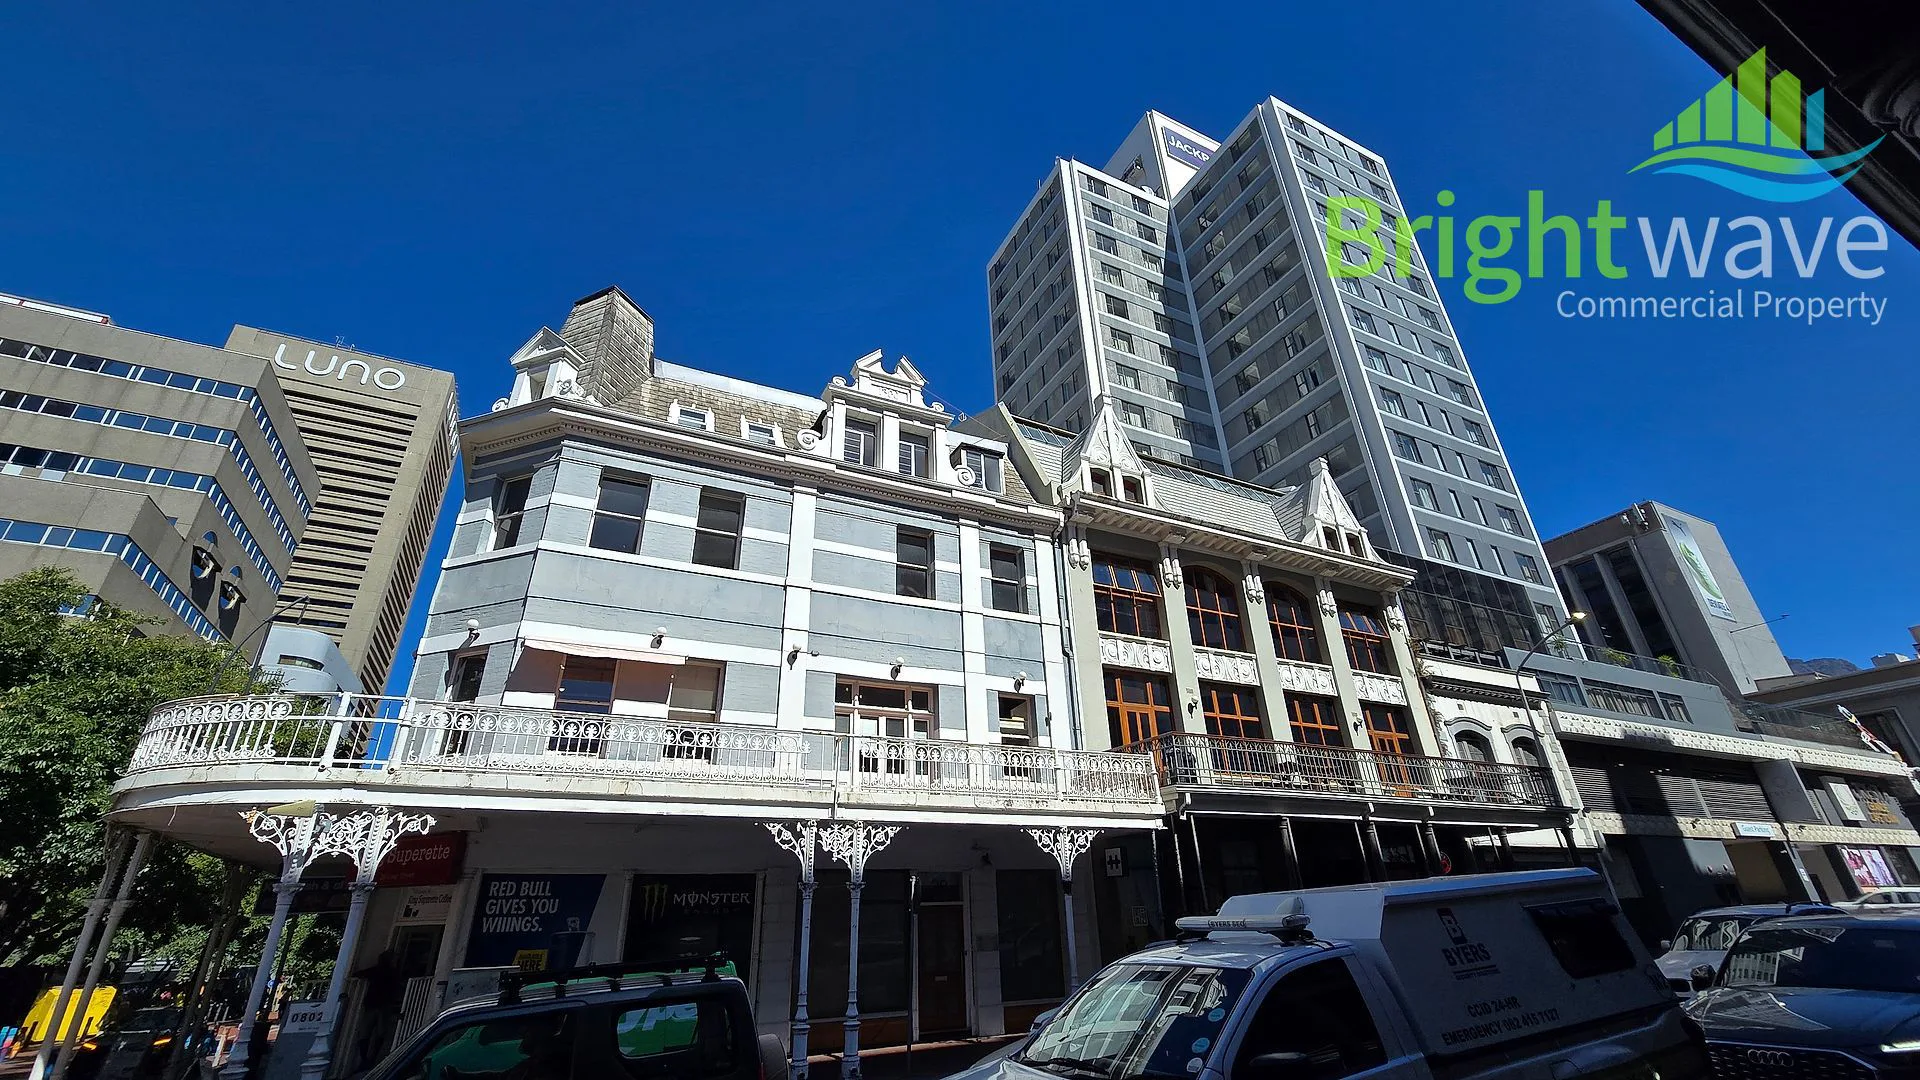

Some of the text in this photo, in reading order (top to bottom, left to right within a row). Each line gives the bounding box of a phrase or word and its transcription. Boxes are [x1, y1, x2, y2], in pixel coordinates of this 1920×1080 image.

[387, 844, 451, 866] Superette
[489, 881, 552, 897] RED BULL
[485, 899, 560, 915] GIVES YOU
[482, 916, 543, 933] WIIINGS.
[1442, 943, 1491, 966] BYERS
[1467, 1002, 1492, 1018] CCID
[1441, 1021, 1503, 1046] EMERGENCY
